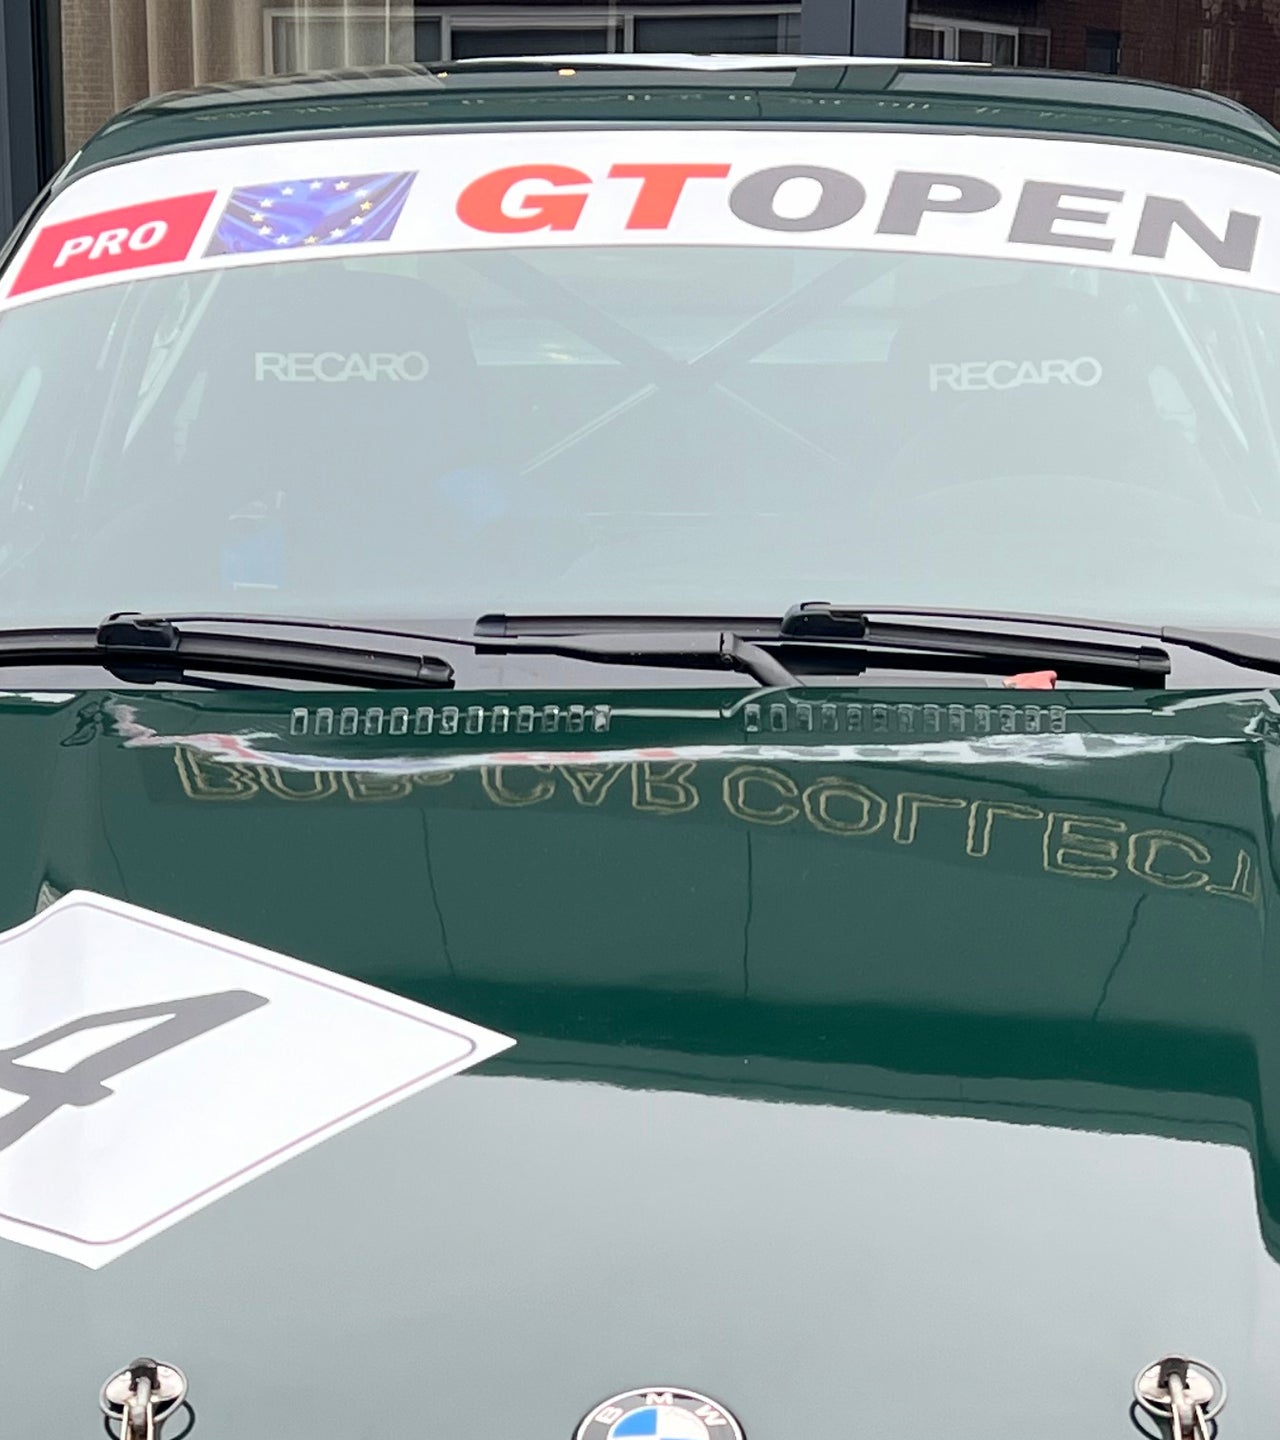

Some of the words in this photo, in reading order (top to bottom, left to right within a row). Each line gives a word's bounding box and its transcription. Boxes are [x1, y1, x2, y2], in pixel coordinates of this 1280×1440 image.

[53, 220, 169, 268] PRO
[255, 350, 429, 382] RECARO
[928, 356, 1103, 392] RECARO
[594, 1391, 728, 1427] BMW
